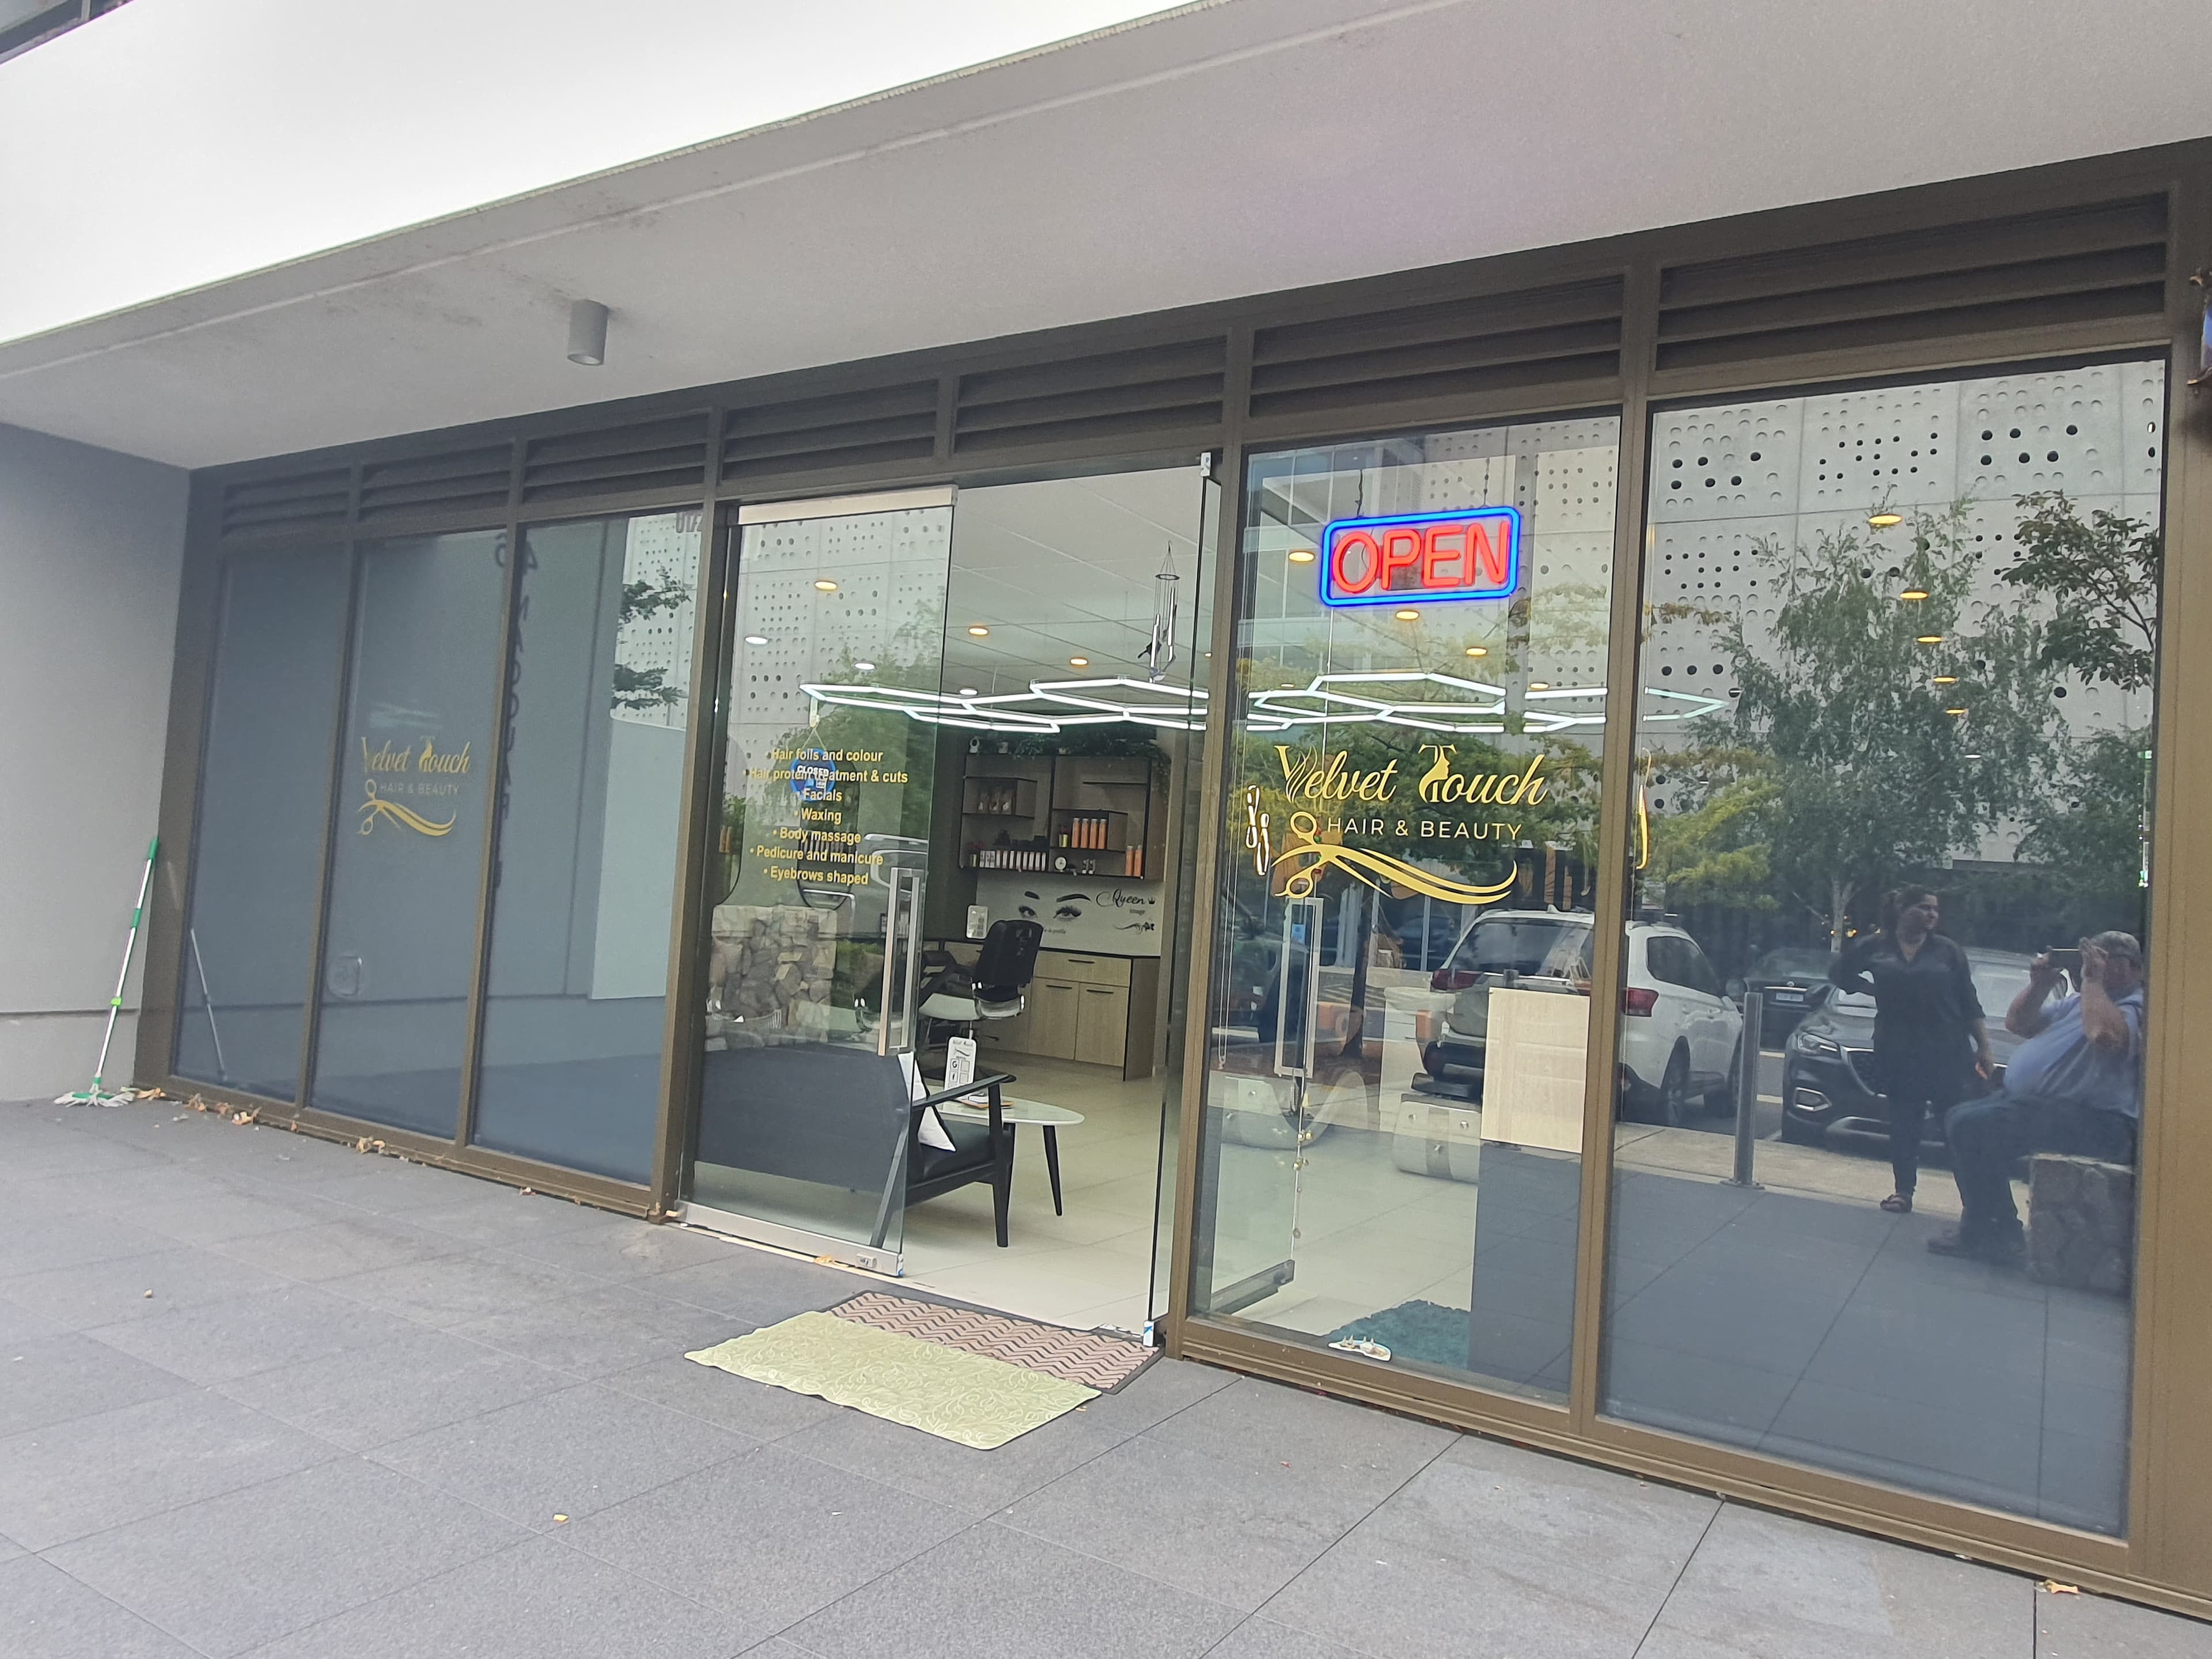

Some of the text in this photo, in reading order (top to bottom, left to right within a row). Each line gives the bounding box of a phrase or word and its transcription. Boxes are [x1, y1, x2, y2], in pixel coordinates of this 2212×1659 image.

[1332, 521, 1510, 594] OPEN
[361, 736, 471, 775] Velvet Touch
[771, 748, 884, 762] Hair foils and colour
[749, 767, 908, 783] Hair protein treatment & cuts
[1274, 743, 1550, 806] Velvet Touch
[380, 783, 403, 793] HAIR
[418, 783, 460, 796] BEAUTY
[803, 787, 843, 801] Facials
[801, 808, 842, 825] Waxing
[779, 827, 861, 846] Body massage
[1327, 817, 1523, 841] HAIR & BEAUTY
[756, 845, 884, 865] Pedicure and manicure
[770, 865, 869, 885] Eyebrows shaped
[1096, 889, 1145, 908] Queen
